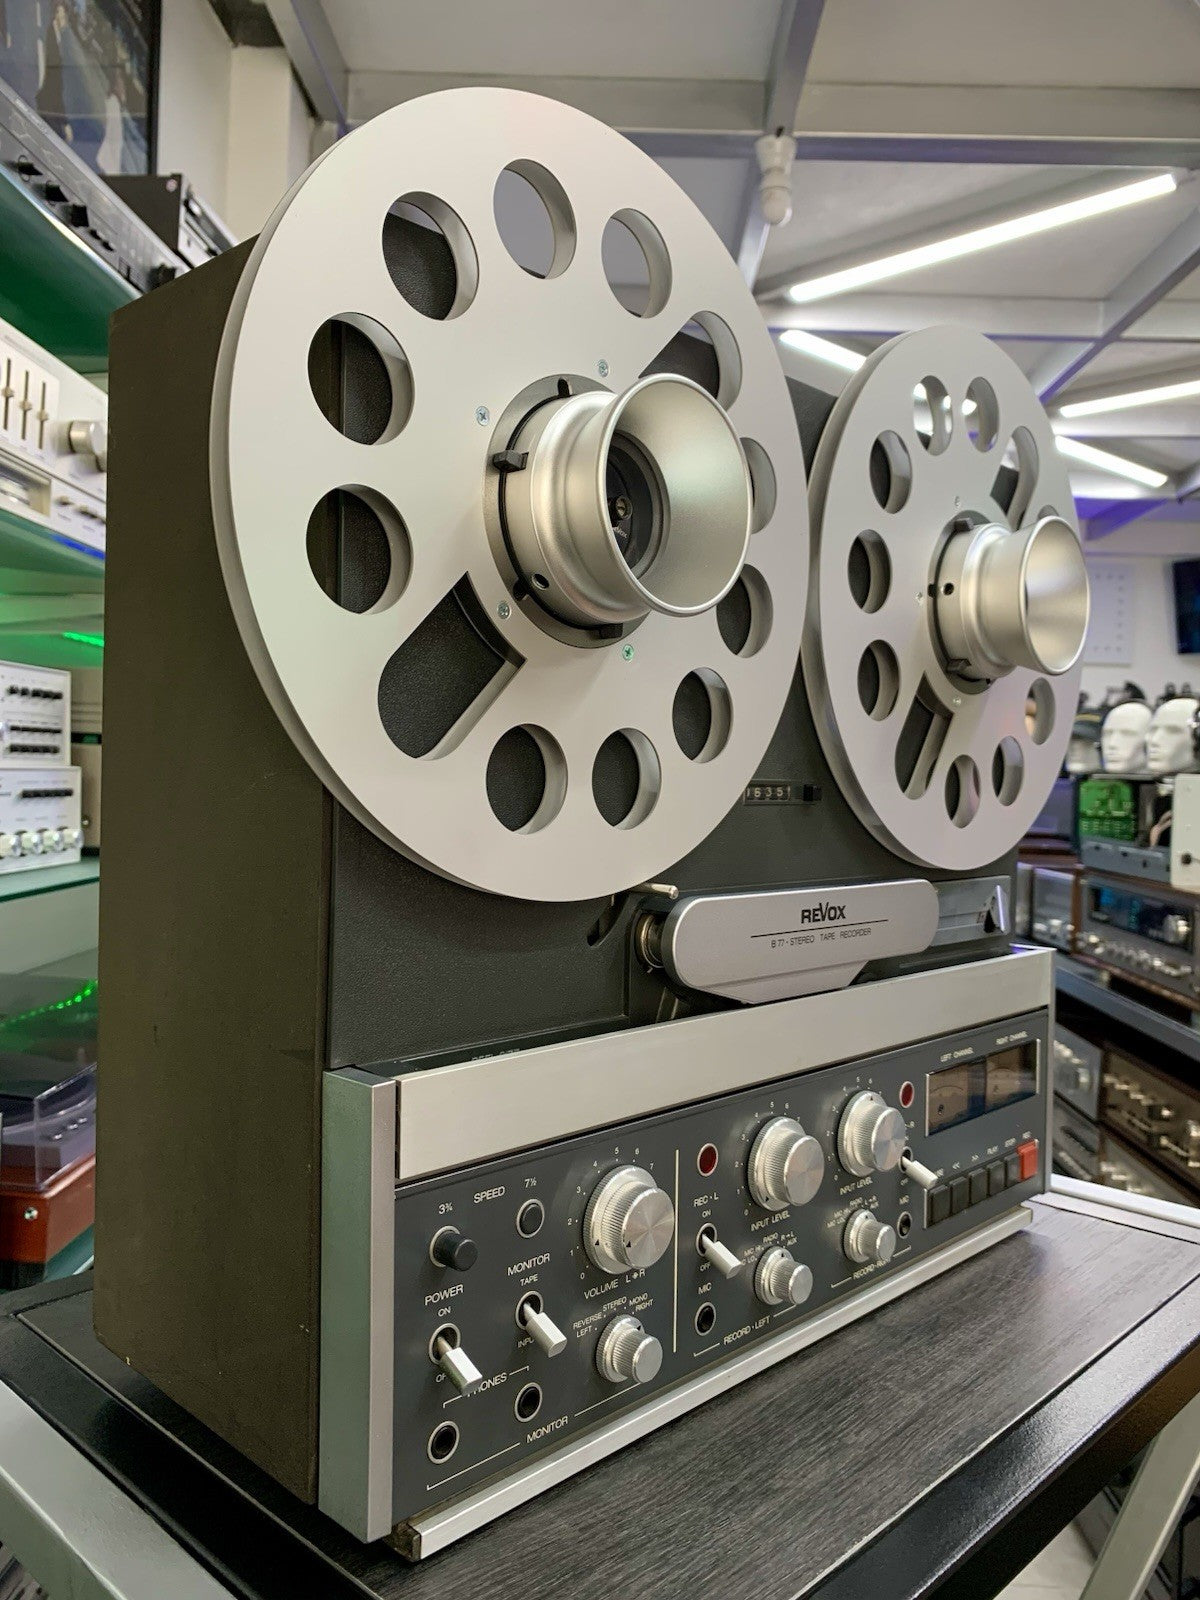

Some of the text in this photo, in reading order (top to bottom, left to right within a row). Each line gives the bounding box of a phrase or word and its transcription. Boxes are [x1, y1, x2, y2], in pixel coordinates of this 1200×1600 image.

[820, 932, 836, 941] TAPE
[840, 927, 872, 939] RECORDER
[473, 1186, 506, 1203] SPEED
[702, 1209, 711, 1218] ON
[751, 1210, 791, 1232] INPUT LEVEL
[507, 1253, 551, 1276] MONITOR
[520, 1274, 539, 1286] TAPE
[424, 1284, 464, 1305] POWER
[584, 1279, 619, 1300] VOLUME
[698, 1283, 712, 1294] MIC
[602, 1296, 627, 1312] STEREO
[629, 1292, 648, 1306] MONO
[635, 1299, 654, 1312] RIGHT
[438, 1306, 451, 1317] ON
[573, 1312, 602, 1330] REVERSE
[576, 1325, 592, 1338] LEFT
[517, 1337, 535, 1348] INPU
[526, 1416, 569, 1443] MONITOR
